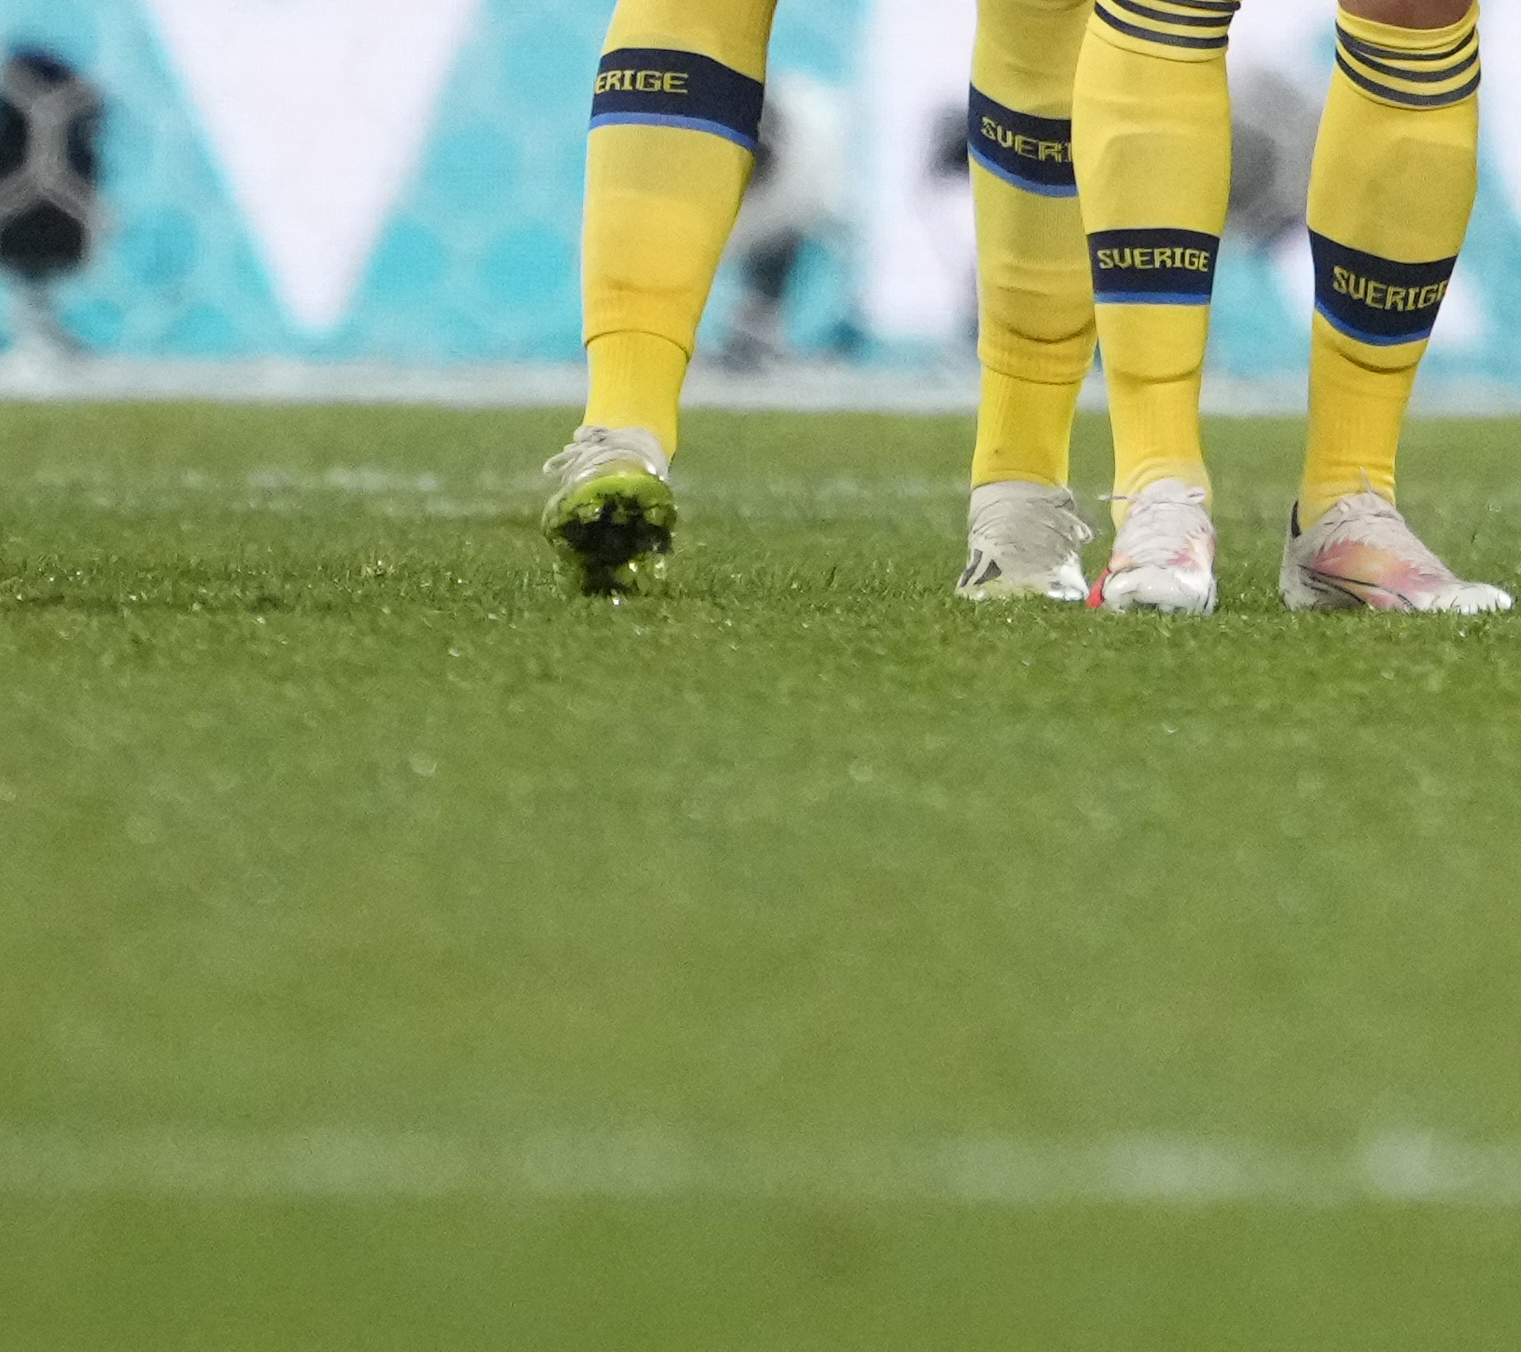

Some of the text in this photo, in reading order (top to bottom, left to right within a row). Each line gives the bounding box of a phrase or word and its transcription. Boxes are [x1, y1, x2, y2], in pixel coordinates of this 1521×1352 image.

[595, 70, 688, 95] ERIGE
[981, 115, 1074, 163] SVERI
[1096, 247, 1210, 272] SVERIGE
